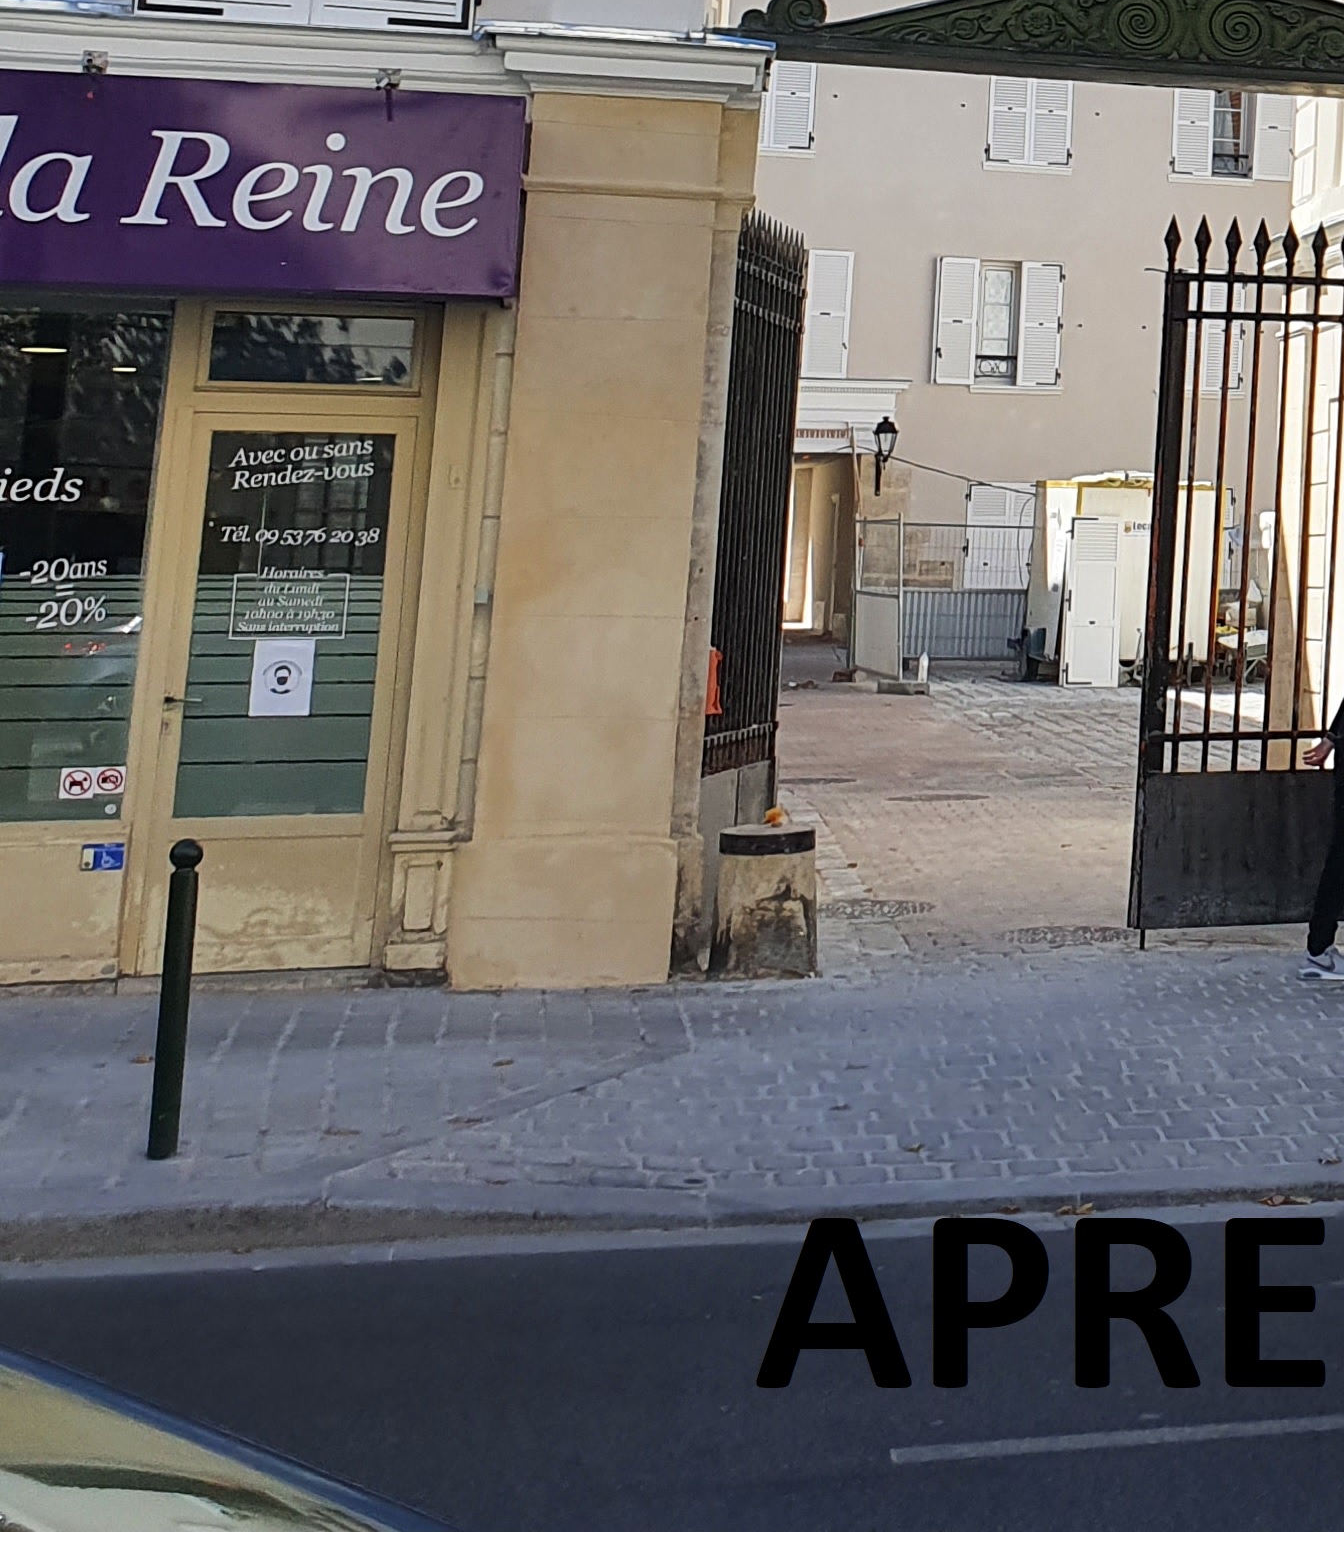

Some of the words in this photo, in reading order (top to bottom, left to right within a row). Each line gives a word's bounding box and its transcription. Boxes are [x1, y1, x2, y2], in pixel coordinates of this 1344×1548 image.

[121, 128, 484, 238] Reine
[228, 448, 285, 468] Avec
[290, 446, 319, 462] ou
[322, 439, 374, 459] sans
[230, 462, 375, 490] Rendez-vous
[220, 525, 250, 542] Tél.
[255, 528, 279, 545] 09
[329, 529, 354, 543] 20
[355, 528, 380, 546] 38
[19, 558, 107, 584] -20ans
[261, 567, 325, 578] Horaires
[25, 596, 107, 629] -20%
[277, 594, 323, 607] Samedi
[236, 621, 265, 631] Sans
[268, 620, 339, 634] interruption
